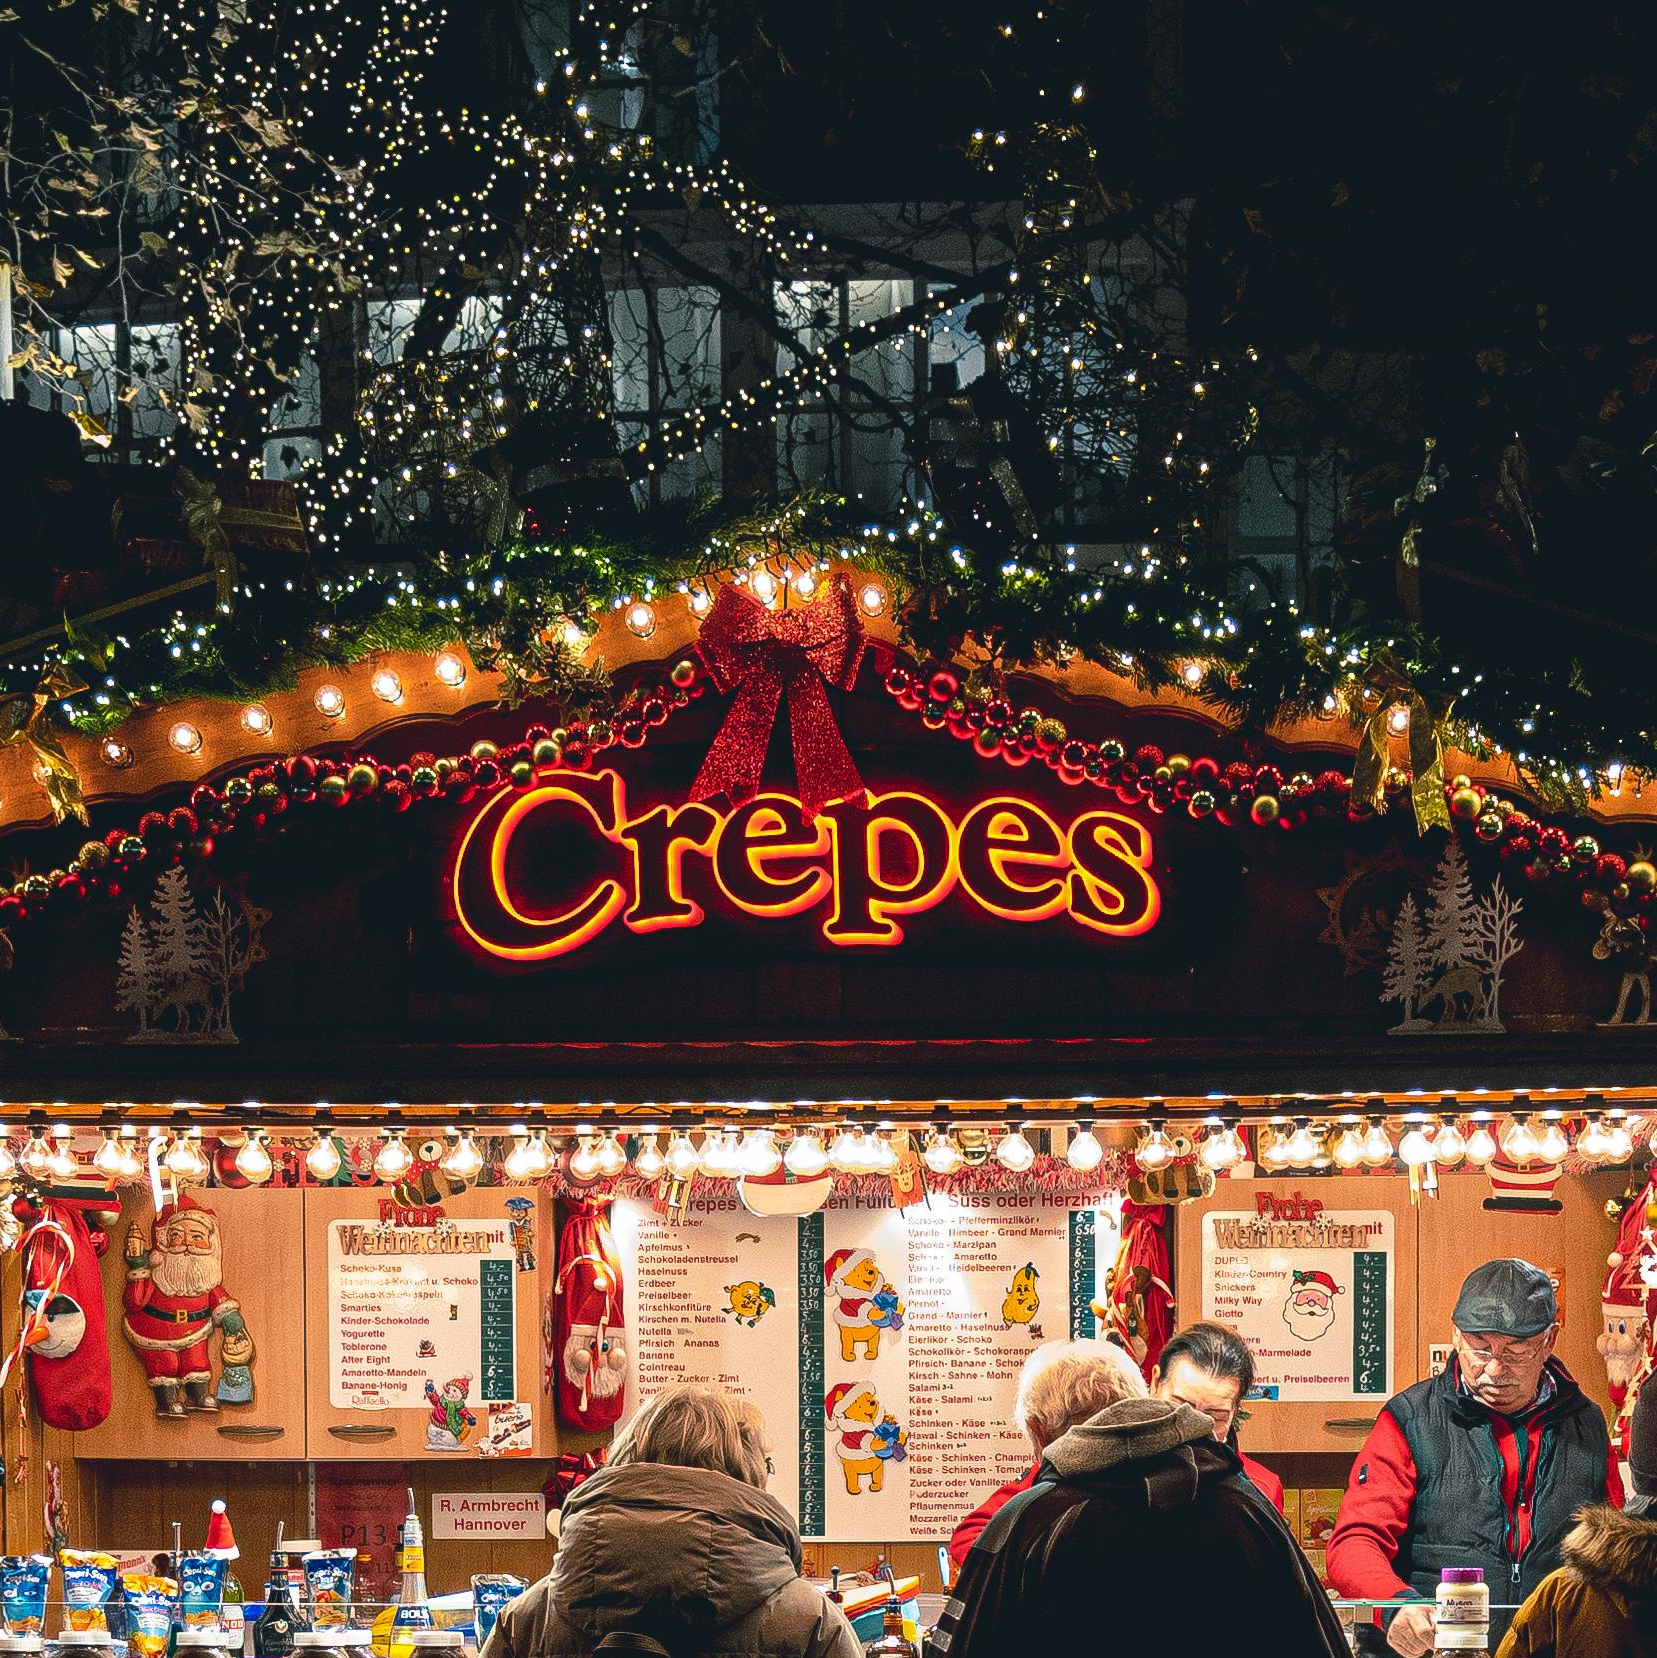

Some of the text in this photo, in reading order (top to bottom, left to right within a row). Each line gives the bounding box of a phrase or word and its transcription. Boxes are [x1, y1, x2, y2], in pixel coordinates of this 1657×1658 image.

[996, 1194, 1035, 1208] oder
[1042, 1192, 1114, 1207] Herzhaft
[689, 1200, 736, 1214] repes
[998, 1228, 1030, 1236] Grand
[1033, 1228, 1066, 1236] Marnier
[638, 1244, 683, 1252] Apfelmus
[954, 1242, 996, 1250] Marzipan
[1215, 1297, 1262, 1305] Milky Way
[342, 1330, 385, 1339] Yogurette
[909, 1348, 1037, 1357] Schokolikör Schokoraspe
[367, 1356, 390, 1365] Eight
[996, 1359, 1025, 1367] Schok
[1284, 1375, 1349, 1383] Preiselbeeren
[342, 1382, 407, 1391] Banane-Honig
[440, 1499, 539, 1512] R. Armbrecht
[454, 1518, 526, 1530] Hannover
[910, 1527, 937, 1535] Weiße
